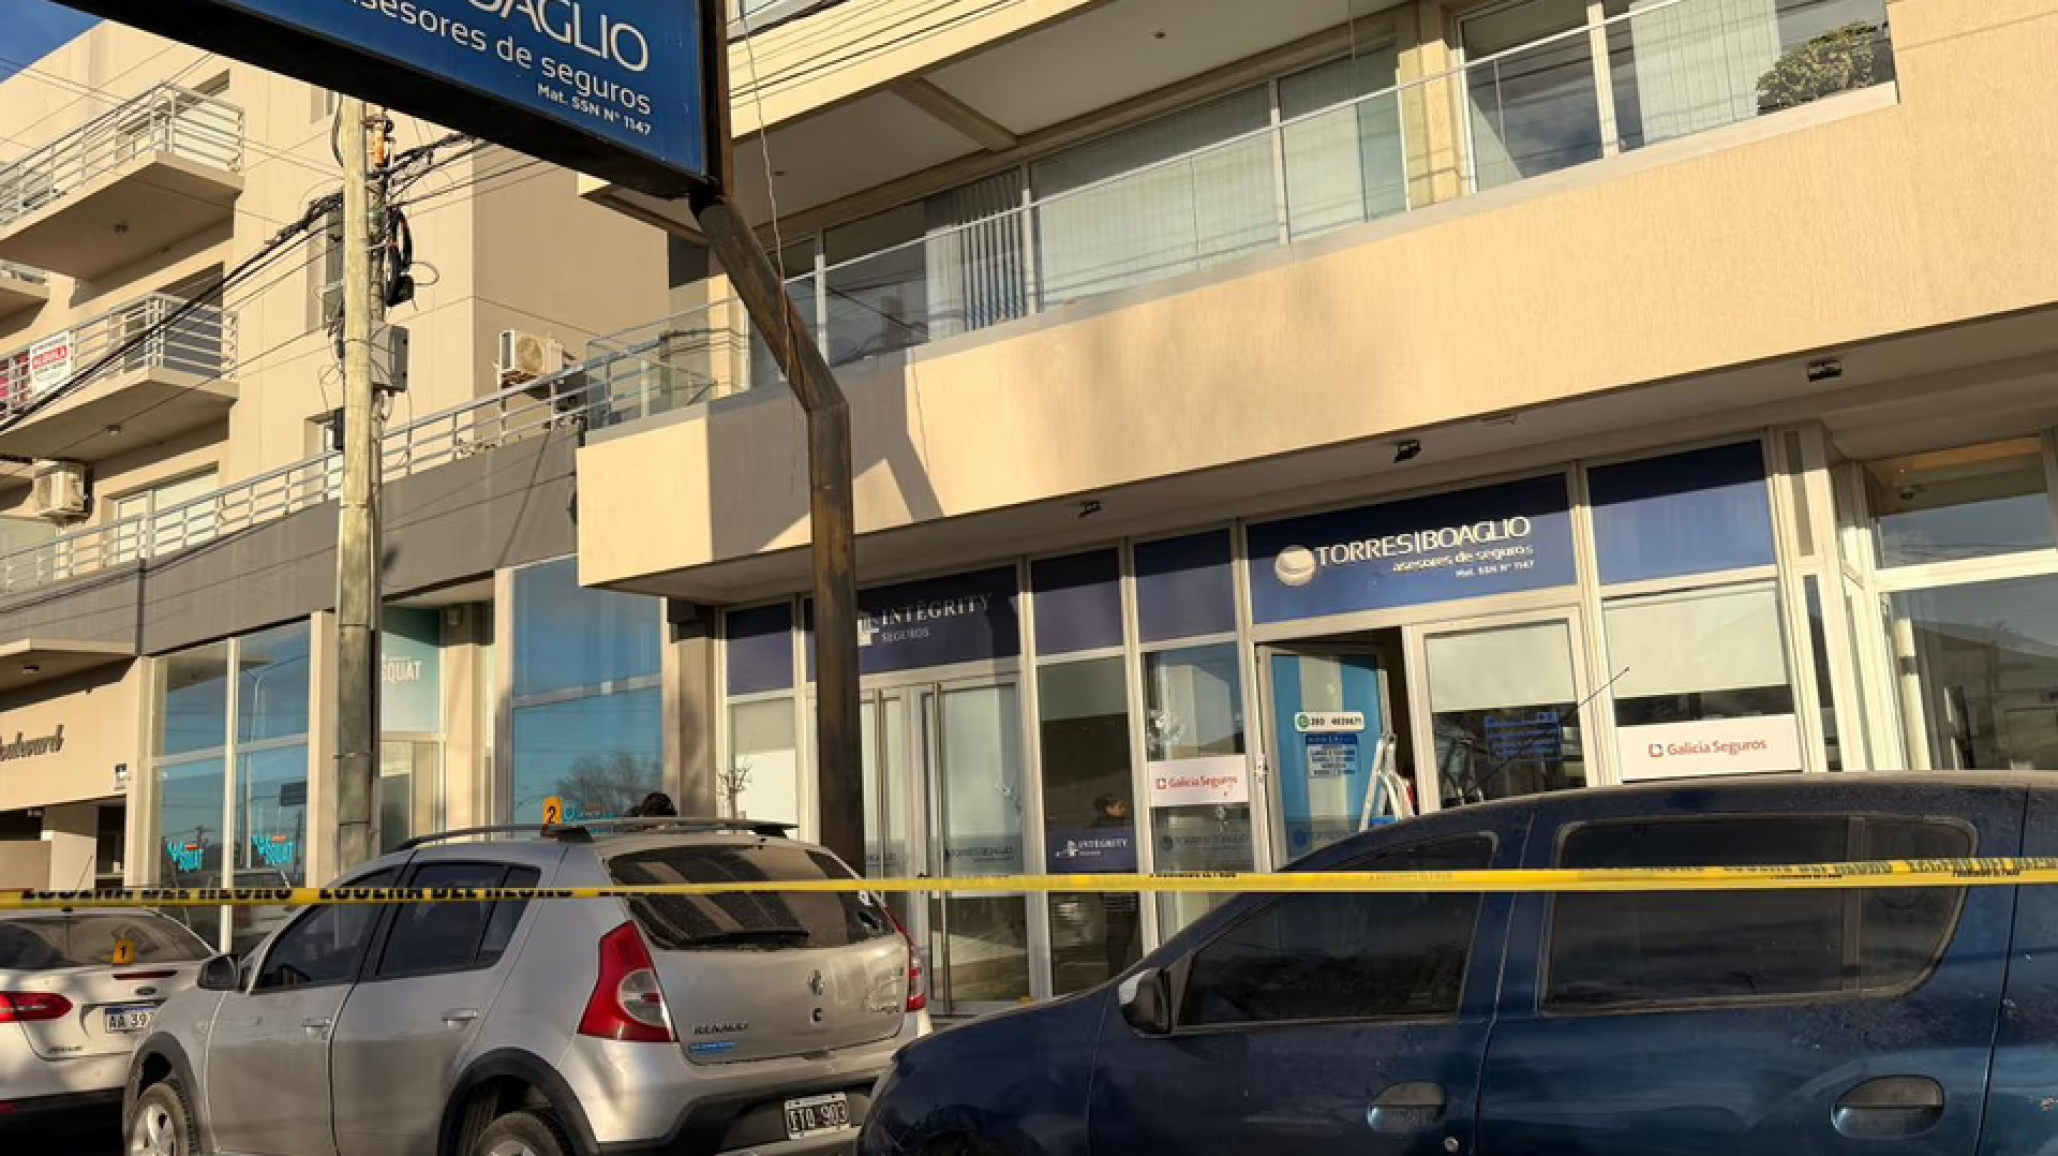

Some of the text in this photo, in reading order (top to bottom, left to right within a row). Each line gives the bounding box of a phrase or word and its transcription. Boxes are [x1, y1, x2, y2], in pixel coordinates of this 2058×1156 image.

[496, 36, 533, 69] de
[541, 57, 651, 115] seguros
[537, 83, 569, 105] Mat.
[572, 96, 600, 117] SSN
[624, 115, 650, 135] 1147
[1393, 545, 1534, 572] asesores de seguros
[882, 592, 992, 625] INTEGRITY
[1667, 739, 1767, 756] Galicia Seguros
[1168, 774, 1238, 789] Galicia Seguros
[546, 805, 557, 823] 2
[1077, 838, 1128, 850] INTEGRITY
